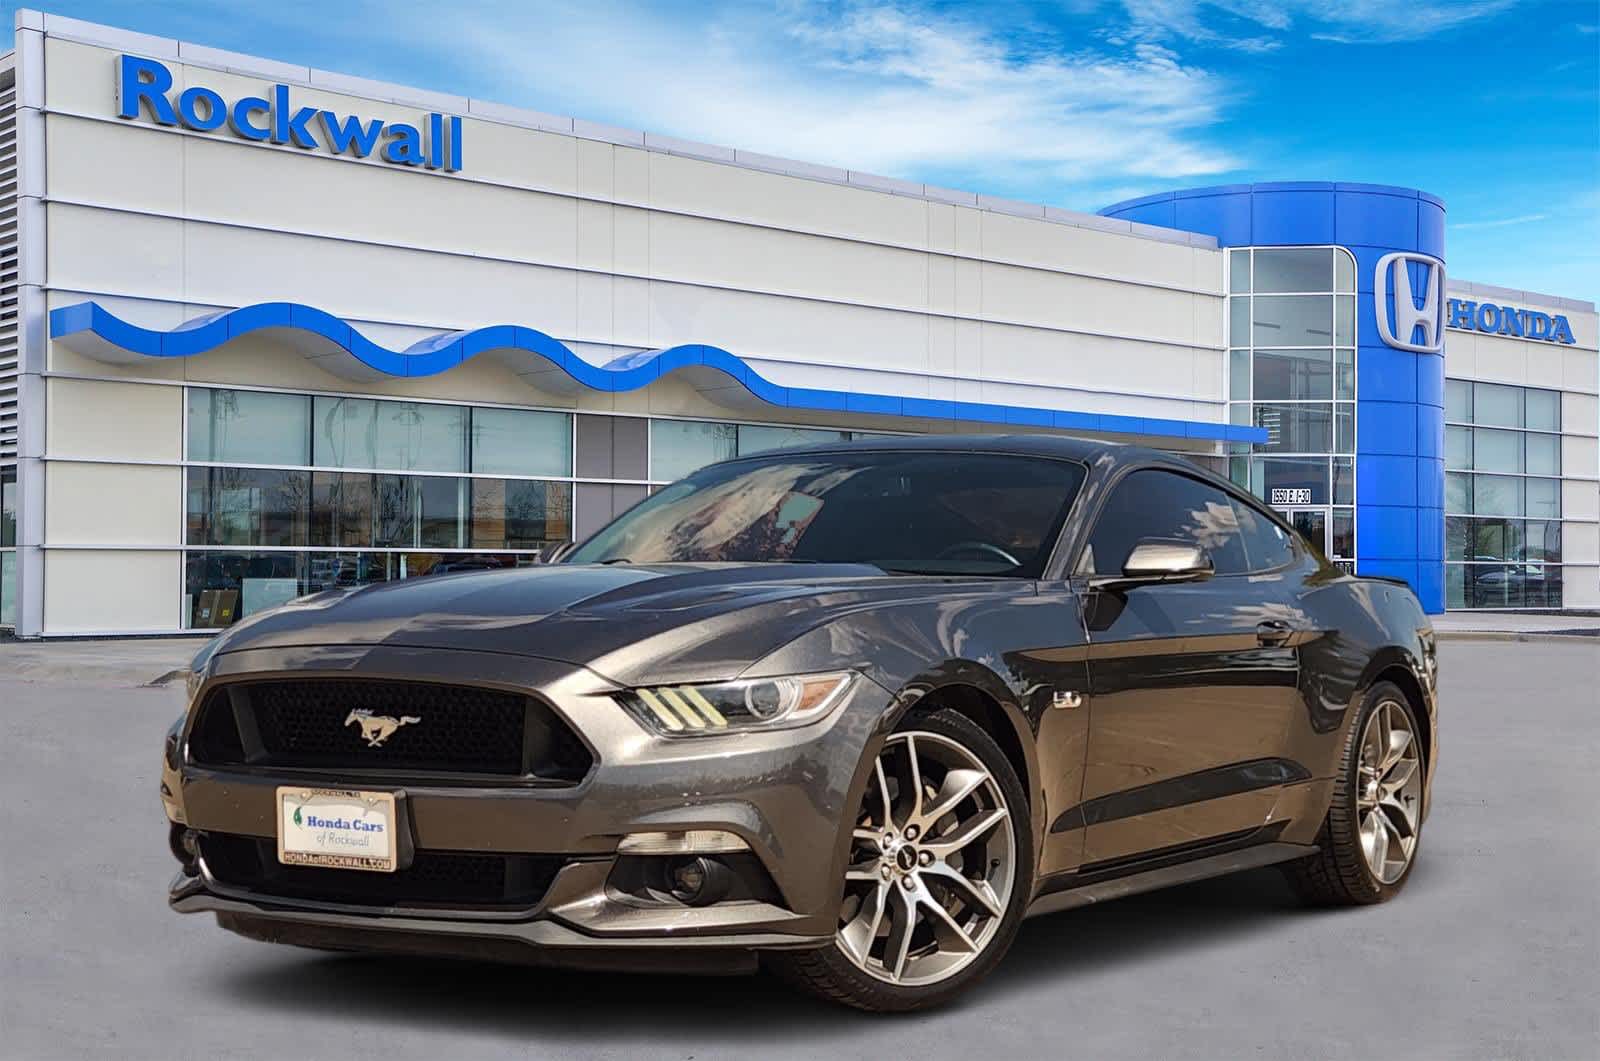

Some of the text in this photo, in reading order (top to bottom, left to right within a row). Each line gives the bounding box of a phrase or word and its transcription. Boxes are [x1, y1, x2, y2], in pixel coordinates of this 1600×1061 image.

[116, 54, 463, 173] Rockwall
[1446, 297, 1576, 345] HONDA
[307, 815, 384, 833] Honda Cars
[316, 831, 370, 848] of Rockwall
